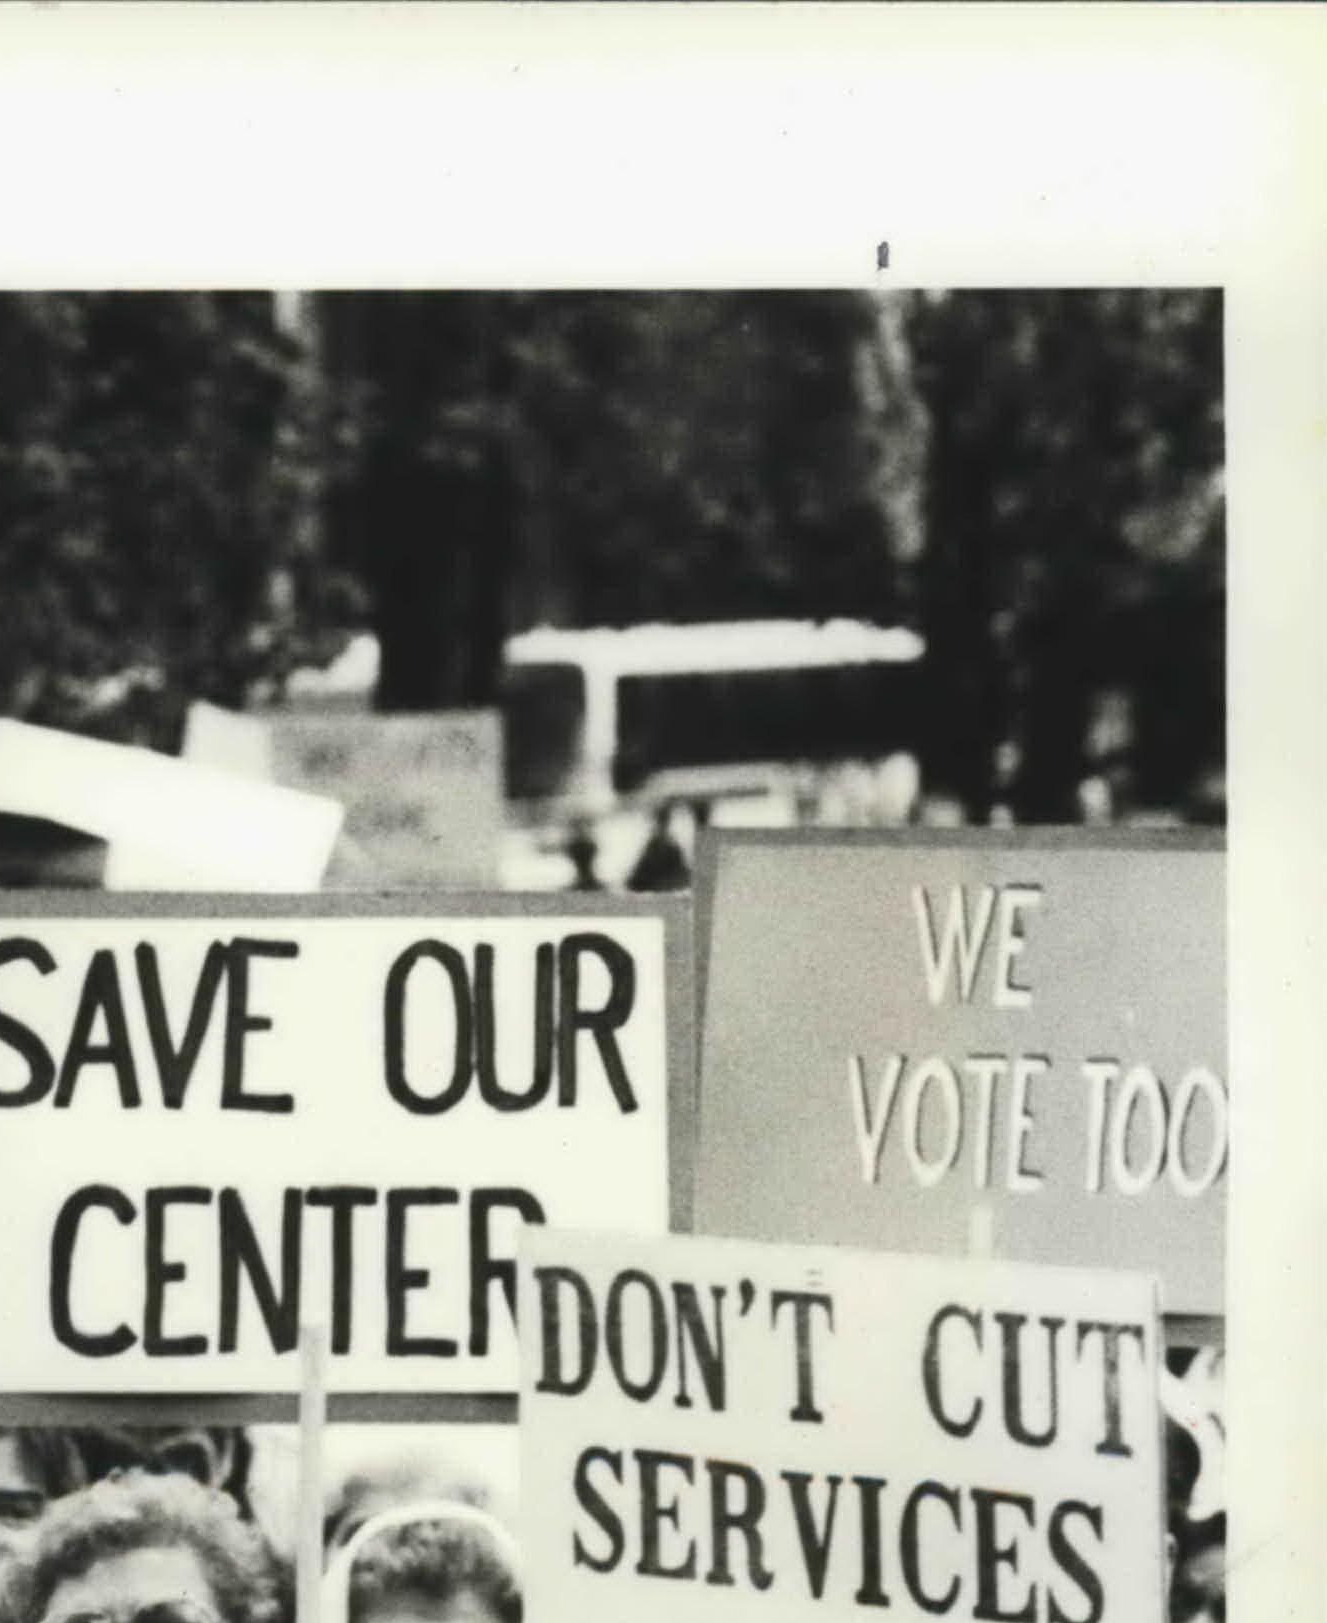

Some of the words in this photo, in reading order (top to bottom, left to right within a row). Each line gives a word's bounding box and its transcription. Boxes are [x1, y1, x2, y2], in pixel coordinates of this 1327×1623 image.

[383, 932, 639, 1116] OUR
[911, 883, 1044, 1009] WE
[847, 1053, 1051, 1194] VOTE
[1081, 1056, 1226, 1197] TOO
[48, 1183, 547, 1359] CENTER
[533, 1265, 834, 1425] DON'T
[920, 1302, 1146, 1458] CUT
